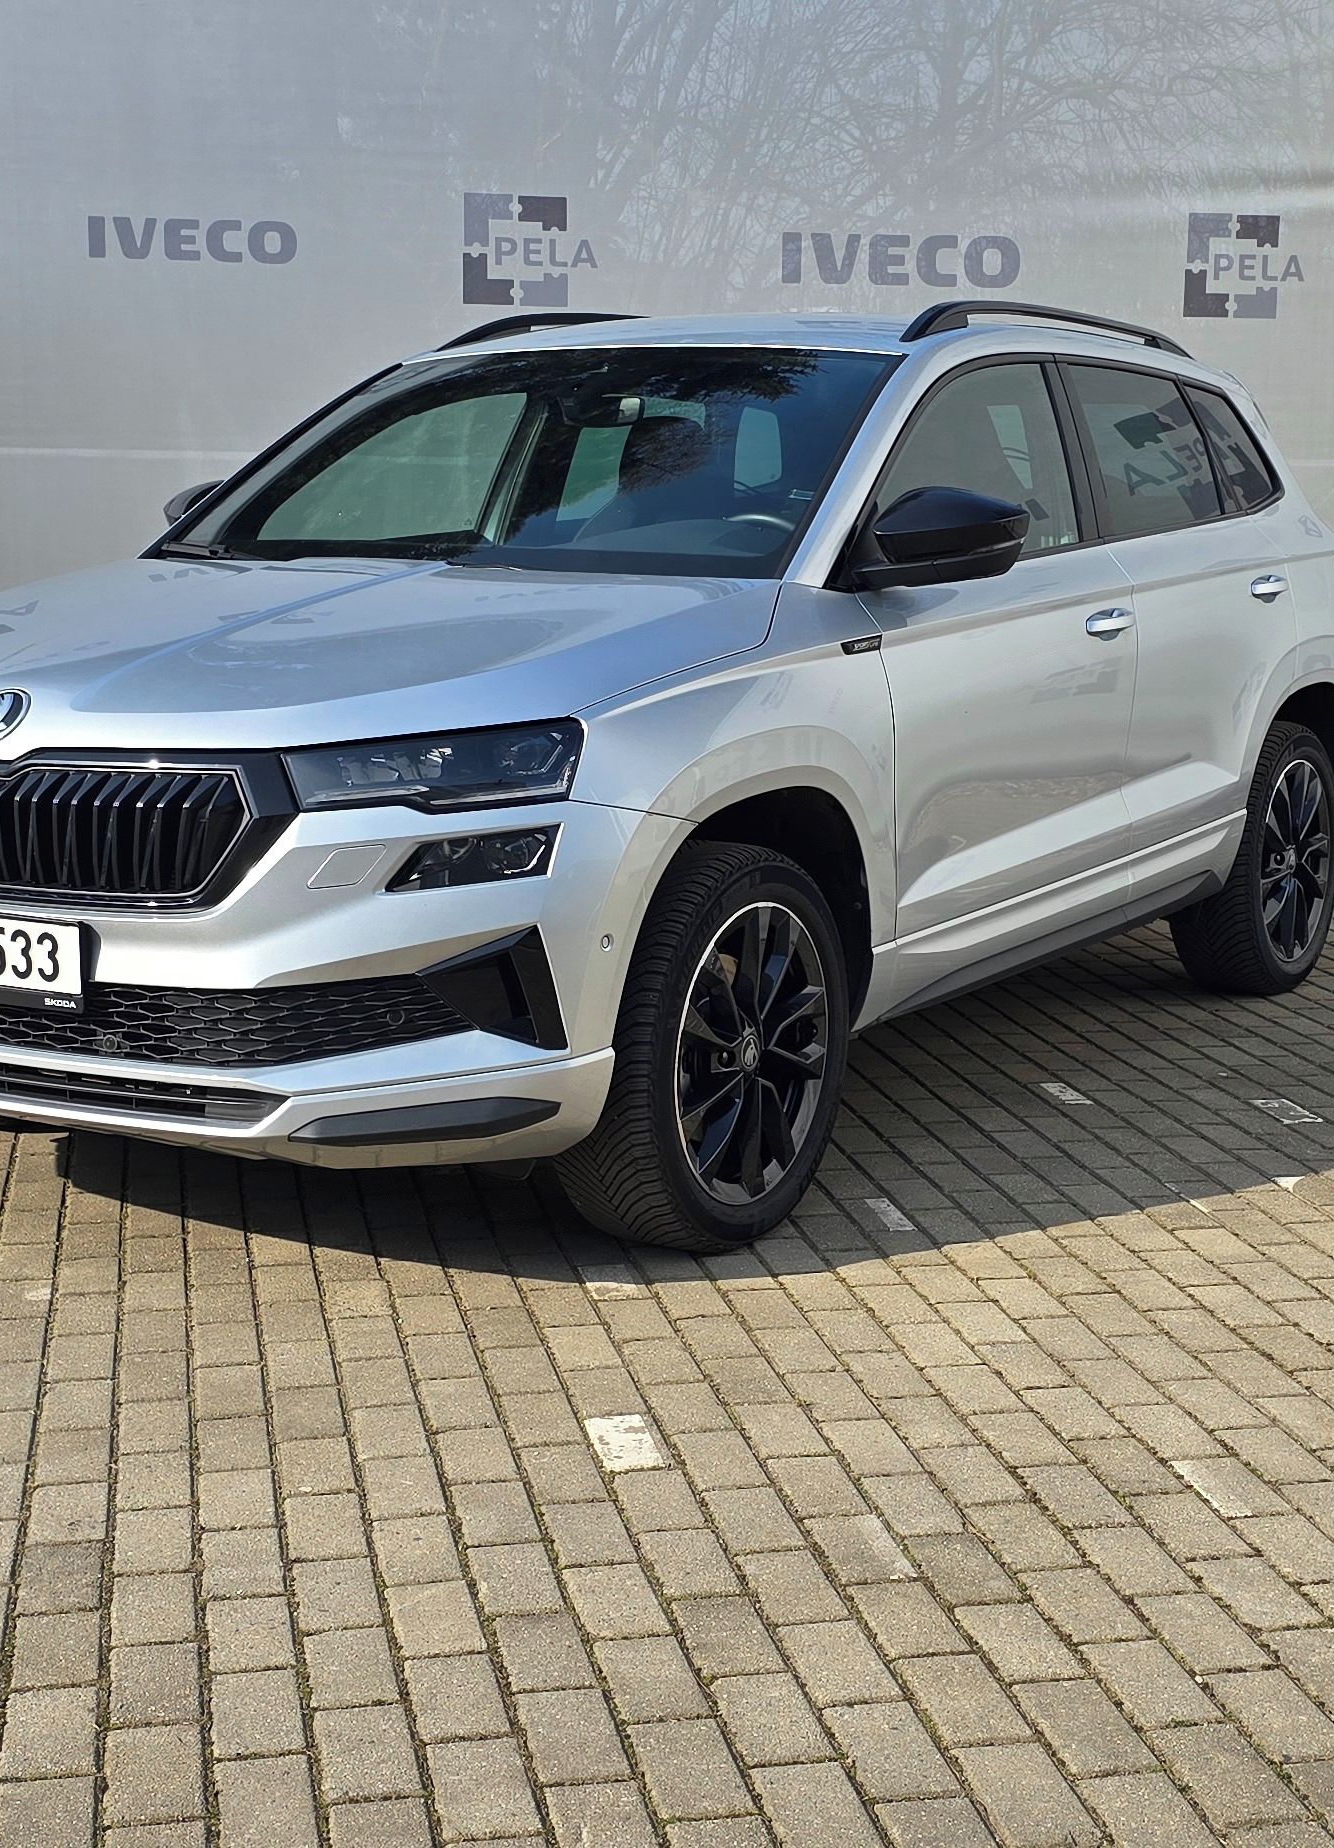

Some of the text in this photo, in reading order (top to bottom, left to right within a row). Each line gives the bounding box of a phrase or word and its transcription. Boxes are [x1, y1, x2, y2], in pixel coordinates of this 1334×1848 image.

[88, 216, 297, 264] IVECO
[495, 237, 597, 268] PELA
[782, 232, 1020, 288] IVECO
[1214, 254, 1304, 281] PELA
